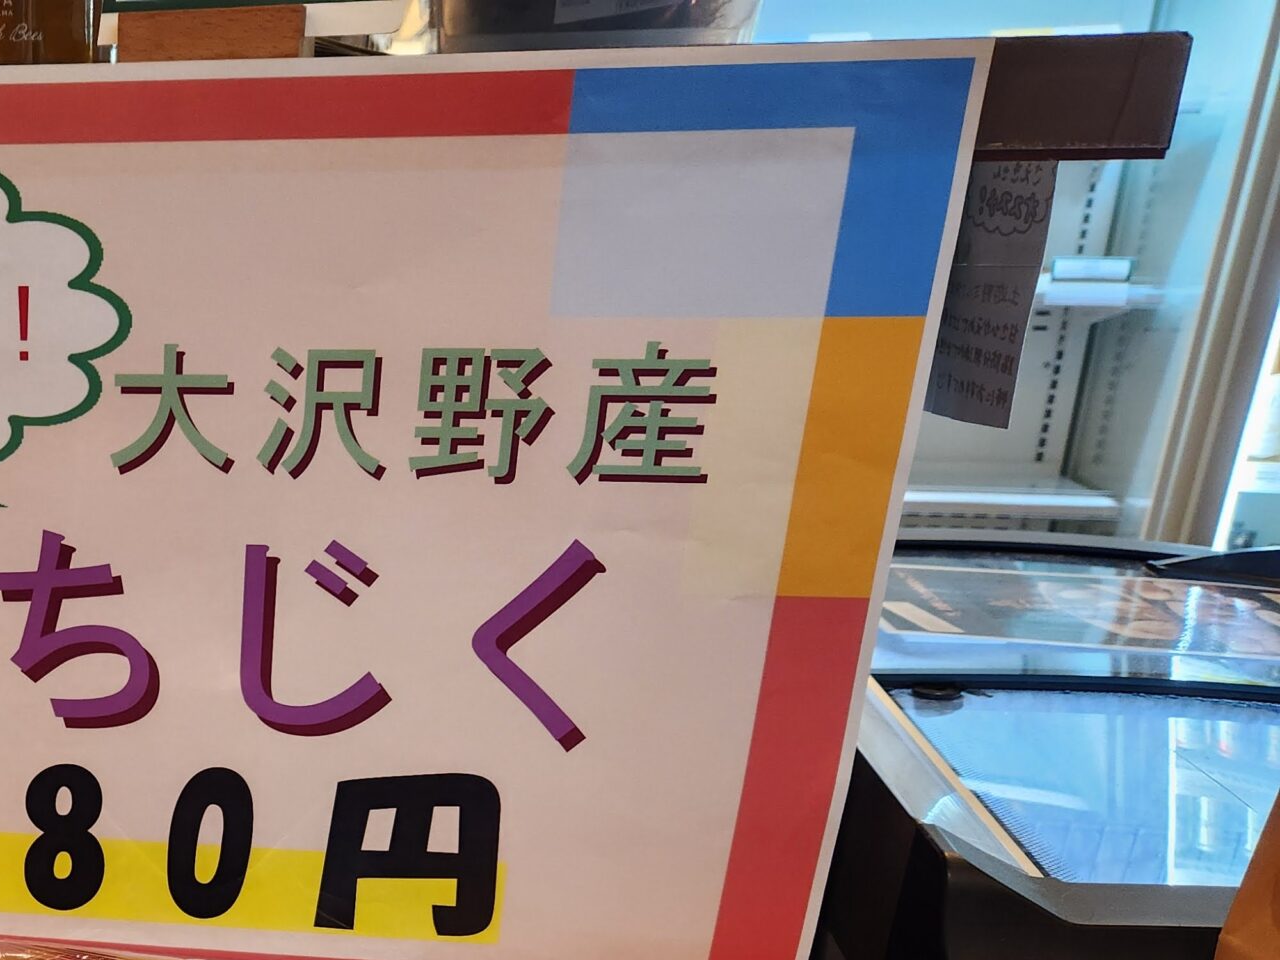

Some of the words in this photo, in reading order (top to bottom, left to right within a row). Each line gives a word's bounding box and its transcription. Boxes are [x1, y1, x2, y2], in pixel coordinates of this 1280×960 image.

[10, 22, 44, 42] Bees
[110, 341, 718, 485] 大沢野産
